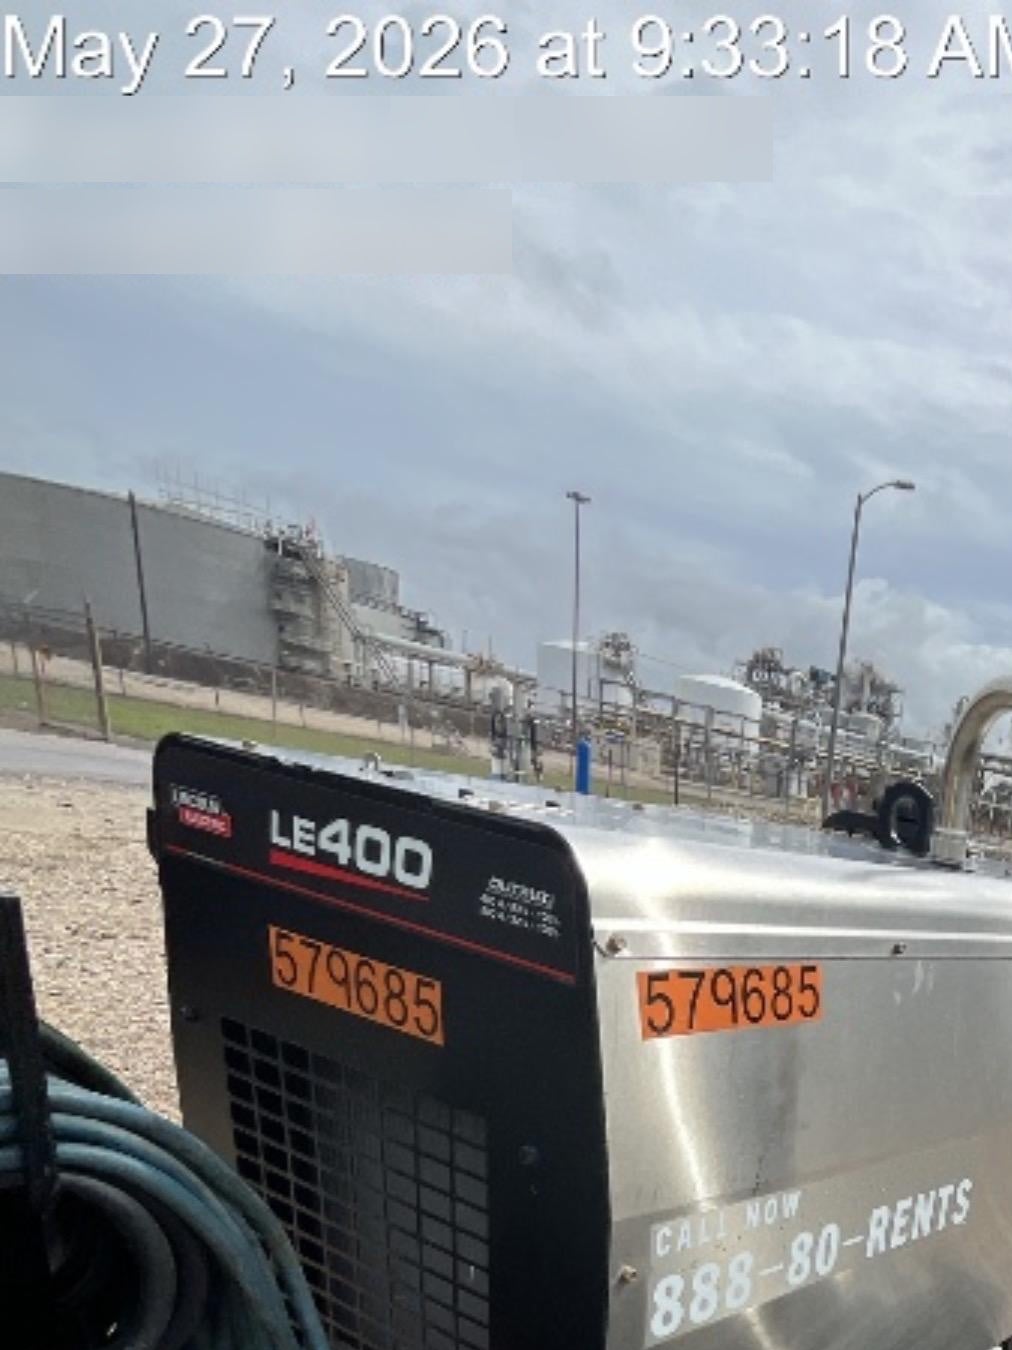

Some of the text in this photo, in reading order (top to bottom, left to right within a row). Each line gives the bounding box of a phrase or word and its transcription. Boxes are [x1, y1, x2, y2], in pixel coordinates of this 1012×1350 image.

[269, 809, 433, 890] LE400
[274, 935, 441, 1038] 579685
[645, 965, 822, 1034] 579685
[650, 1177, 974, 1337] 888-80-RENTS
[656, 1190, 803, 1257] CALL NOW
